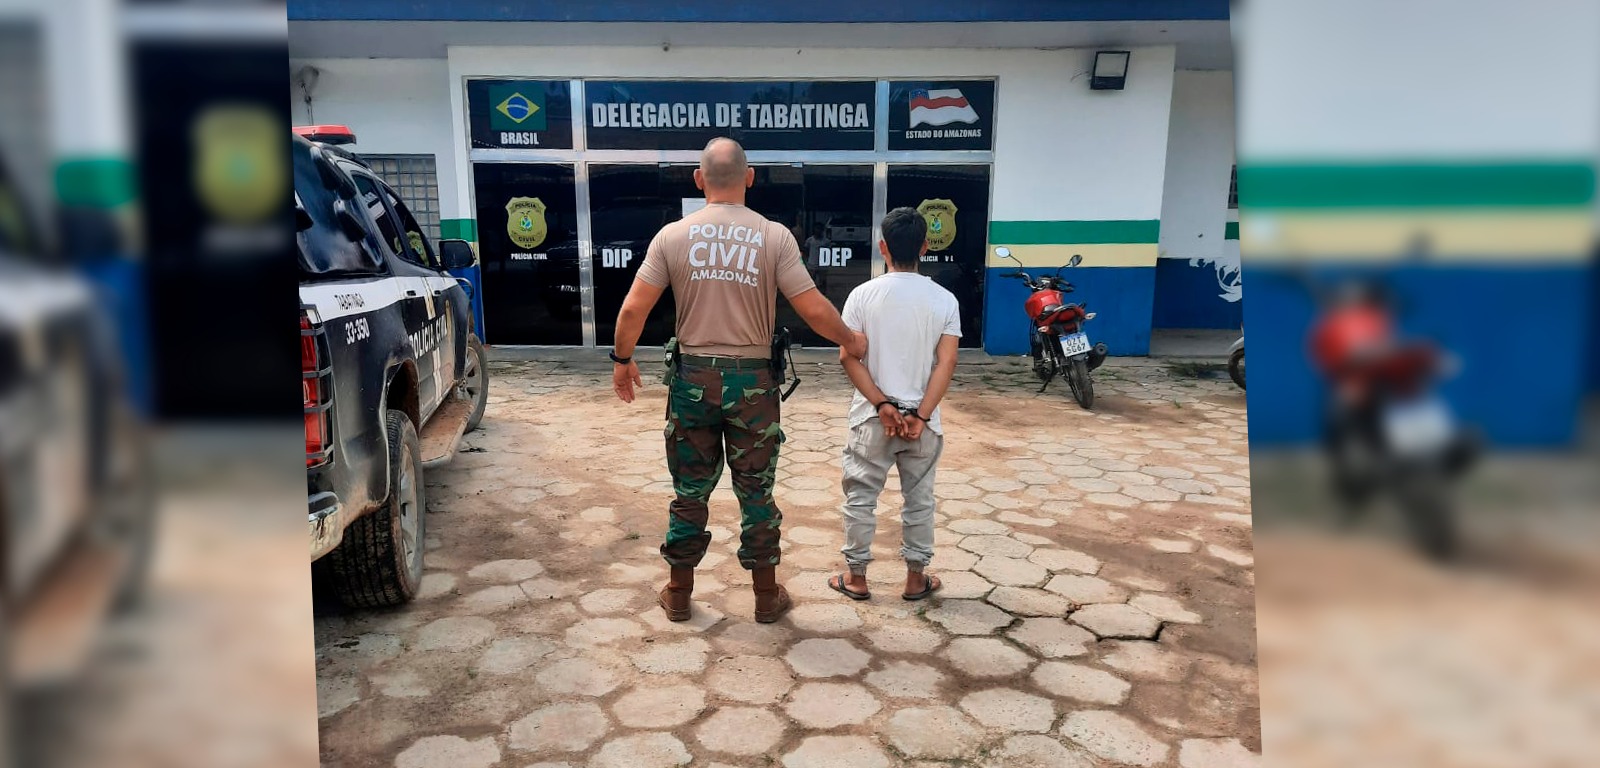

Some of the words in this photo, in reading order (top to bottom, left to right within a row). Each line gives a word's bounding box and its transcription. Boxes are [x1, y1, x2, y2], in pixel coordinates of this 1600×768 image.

[592, 102, 709, 128] DELEGACIA
[715, 103, 742, 128] DE
[747, 103, 869, 128] TABATINGA
[501, 132, 539, 145] BRASIL
[905, 130, 932, 139] ESTADO
[944, 129, 982, 138] AMAZONAS
[688, 222, 763, 247] POLÍCIA
[533, 252, 548, 260] CIVIL
[602, 249, 633, 269] DIP
[688, 241, 760, 275] CIVIL
[818, 247, 853, 267] DEP
[690, 269, 758, 287] AMAZONAS
[334, 292, 366, 311] TABATINGA
[345, 317, 370, 345] 33-350
